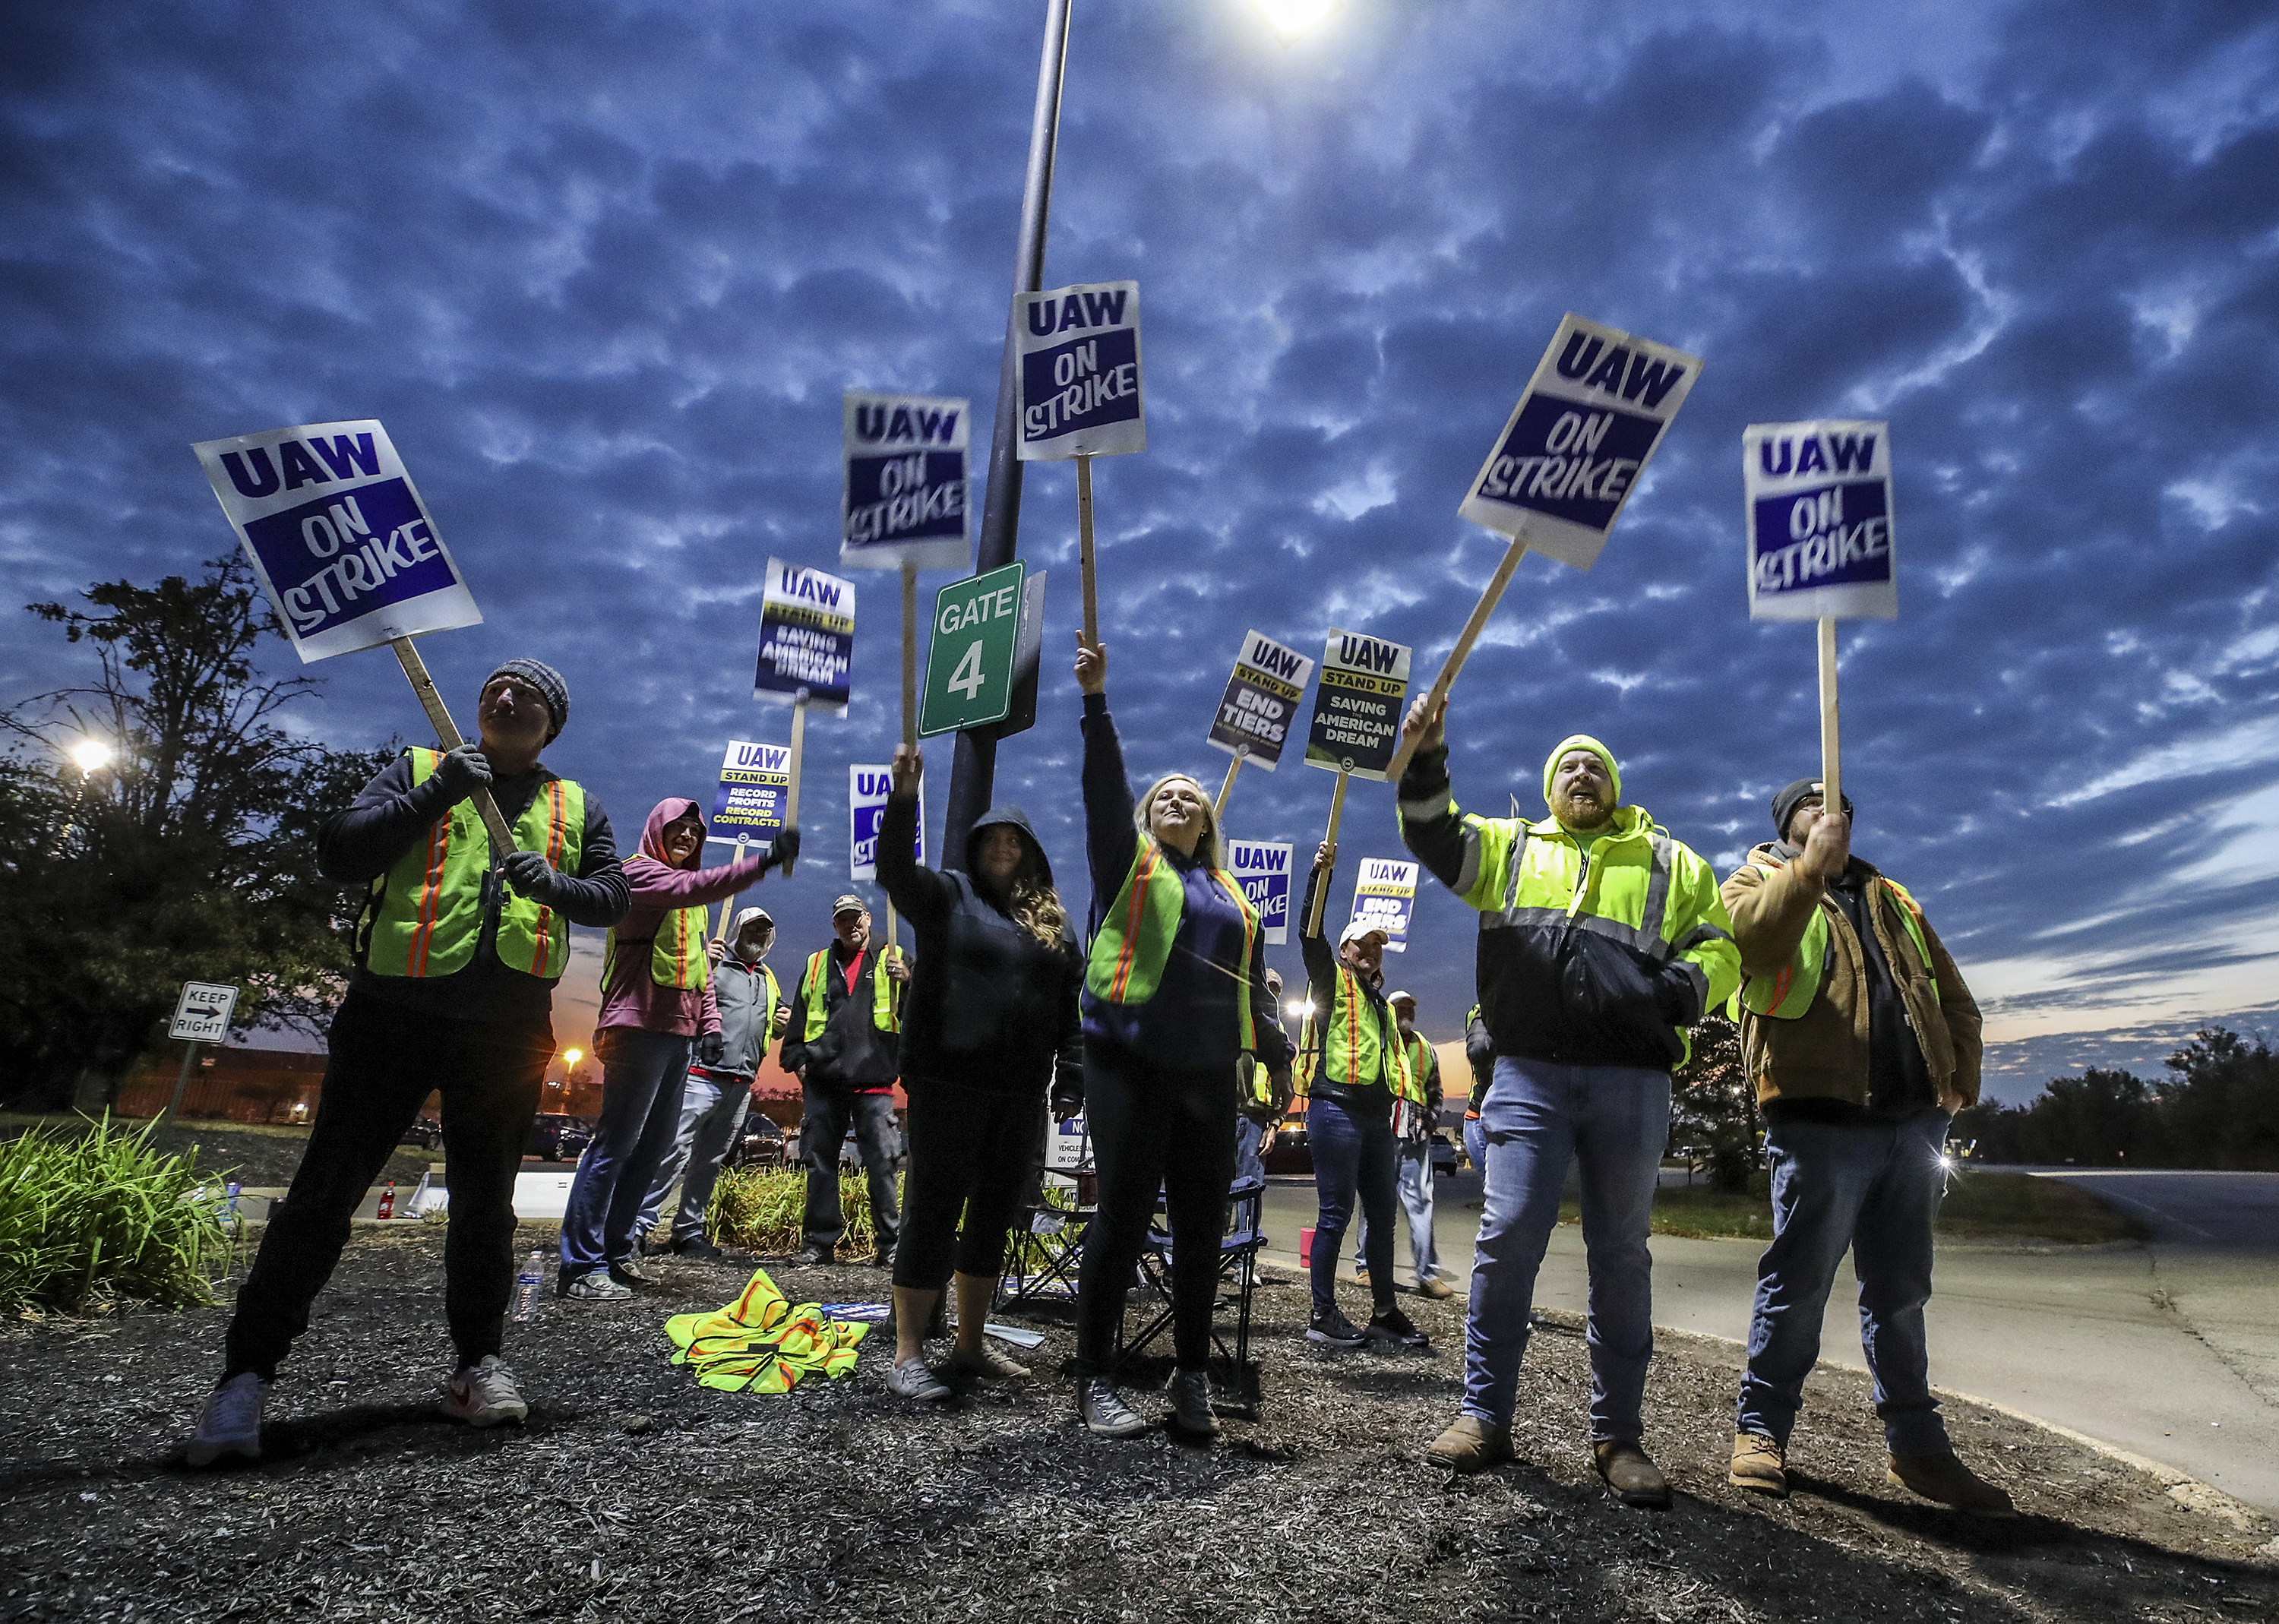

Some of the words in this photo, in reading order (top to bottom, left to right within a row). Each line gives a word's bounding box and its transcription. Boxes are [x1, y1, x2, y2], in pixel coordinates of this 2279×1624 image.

[1029, 290, 1127, 336] UAW
[1054, 340, 1097, 387] ON
[1557, 329, 1688, 410] UAW
[1026, 362, 1137, 438] STRIKE
[856, 405, 960, 443] UAW
[1545, 411, 1615, 456] ON
[220, 432, 381, 498] UAW
[1760, 434, 1876, 476] UAW
[880, 453, 927, 498] ON
[1482, 453, 1639, 501] STRIKE
[301, 495, 371, 558] ON
[847, 479, 963, 544] STRIKE
[1790, 483, 1843, 541] ON
[1756, 516, 1888, 591] STRIKE
[283, 518, 439, 632] STRIKE
[782, 567, 841, 607] UAW
[939, 585, 1015, 635] GATE
[947, 640, 985, 700] 4
[1252, 640, 1304, 681] UAW
[1340, 635, 1399, 675] UAW
[1326, 672, 1376, 690] STAND
[1380, 682, 1401, 695] UP
[1224, 703, 1286, 742] TIERS
[1236, 687, 1284, 720] END
[1330, 696, 1386, 716] SAVING
[1314, 712, 1395, 737] AMERICAN
[1326, 728, 1380, 749] DREAM
[738, 745, 787, 769] UAW
[725, 772, 767, 782] STAND
[771, 776, 788, 784] UP
[730, 787, 777, 799] RECORD
[858, 773, 892, 796] UA
[713, 814, 781, 828] CONTRACTS
[725, 806, 773, 817] RECORD
[727, 797, 775, 808] PROFITS
[1235, 847, 1287, 870] UAW
[1370, 864, 1408, 882] UAW
[1246, 877, 1269, 901] ON
[1363, 898, 1402, 914] END
[188, 991, 229, 1003] KEEP
[175, 1019, 222, 1033] RIGHT
